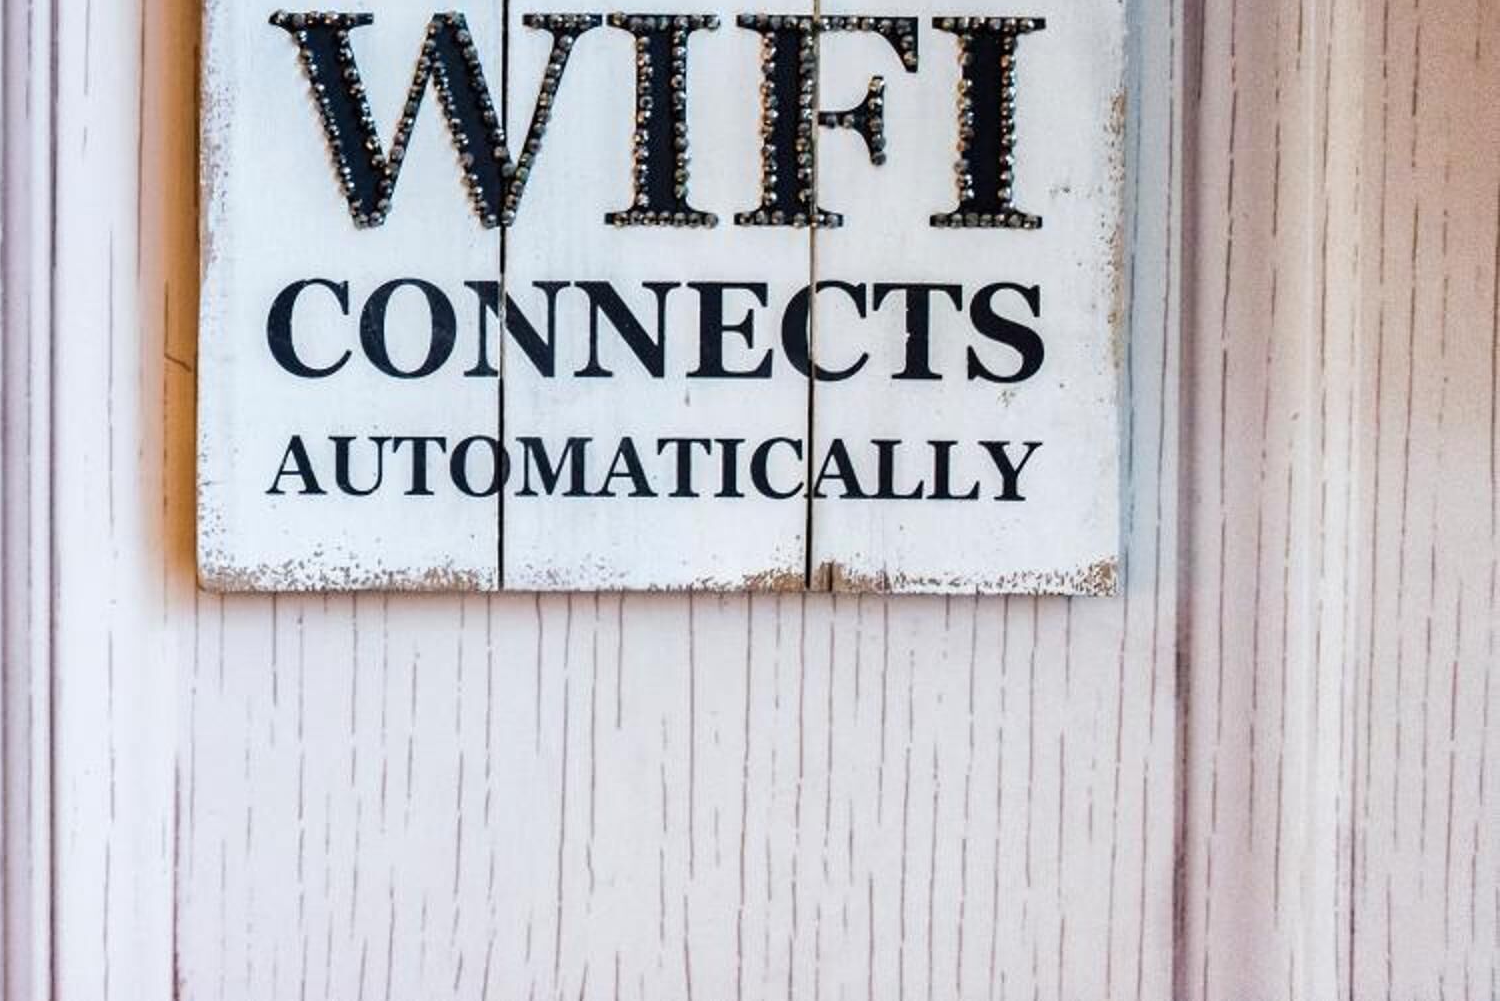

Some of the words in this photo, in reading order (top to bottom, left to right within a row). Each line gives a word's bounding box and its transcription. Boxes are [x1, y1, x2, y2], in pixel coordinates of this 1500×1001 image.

[267, 10, 1048, 230] WIFI
[265, 277, 1047, 383] CONNECTS
[264, 434, 1045, 503] AUTOMATICALLY
